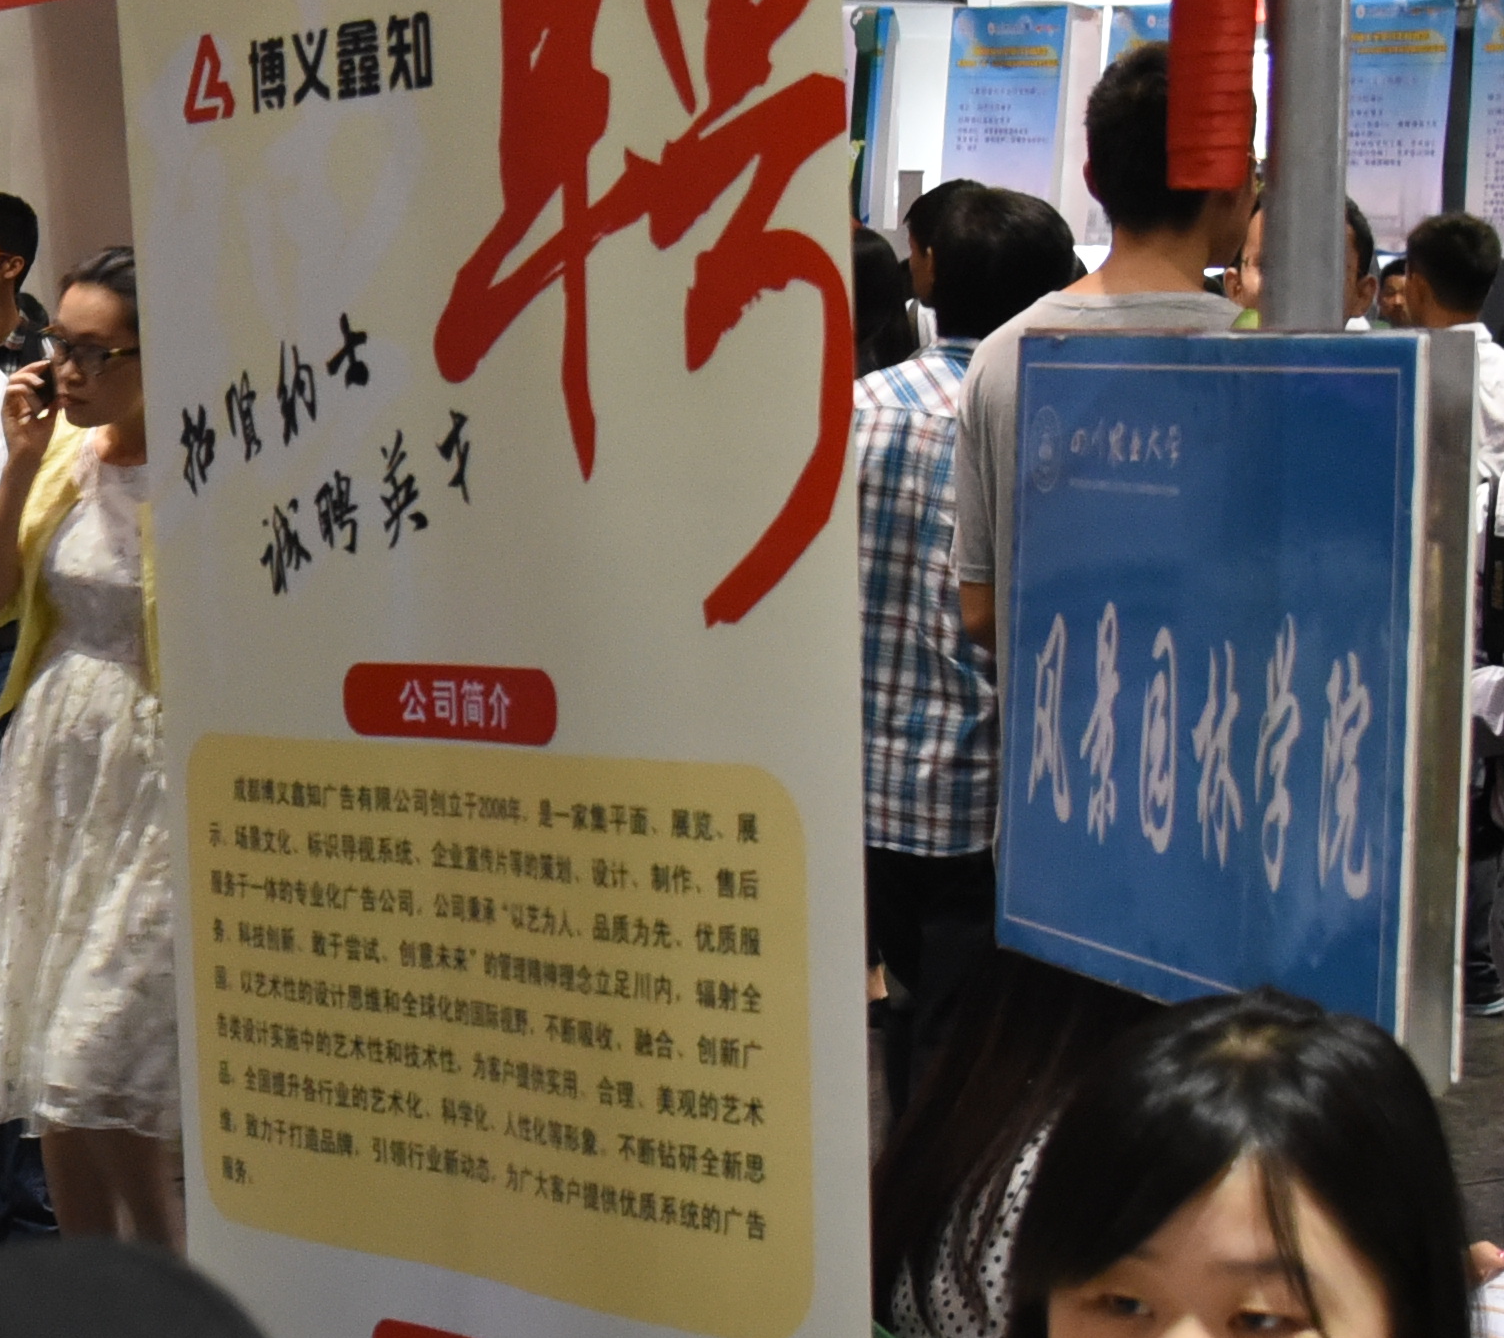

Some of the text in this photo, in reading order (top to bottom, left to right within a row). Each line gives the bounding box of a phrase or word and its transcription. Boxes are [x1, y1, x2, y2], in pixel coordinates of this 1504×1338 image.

[247, 10, 435, 114] 博义鑫知
[398, 678, 512, 730] 公司简介
[1026, 600, 1371, 901] 风景园林学院
